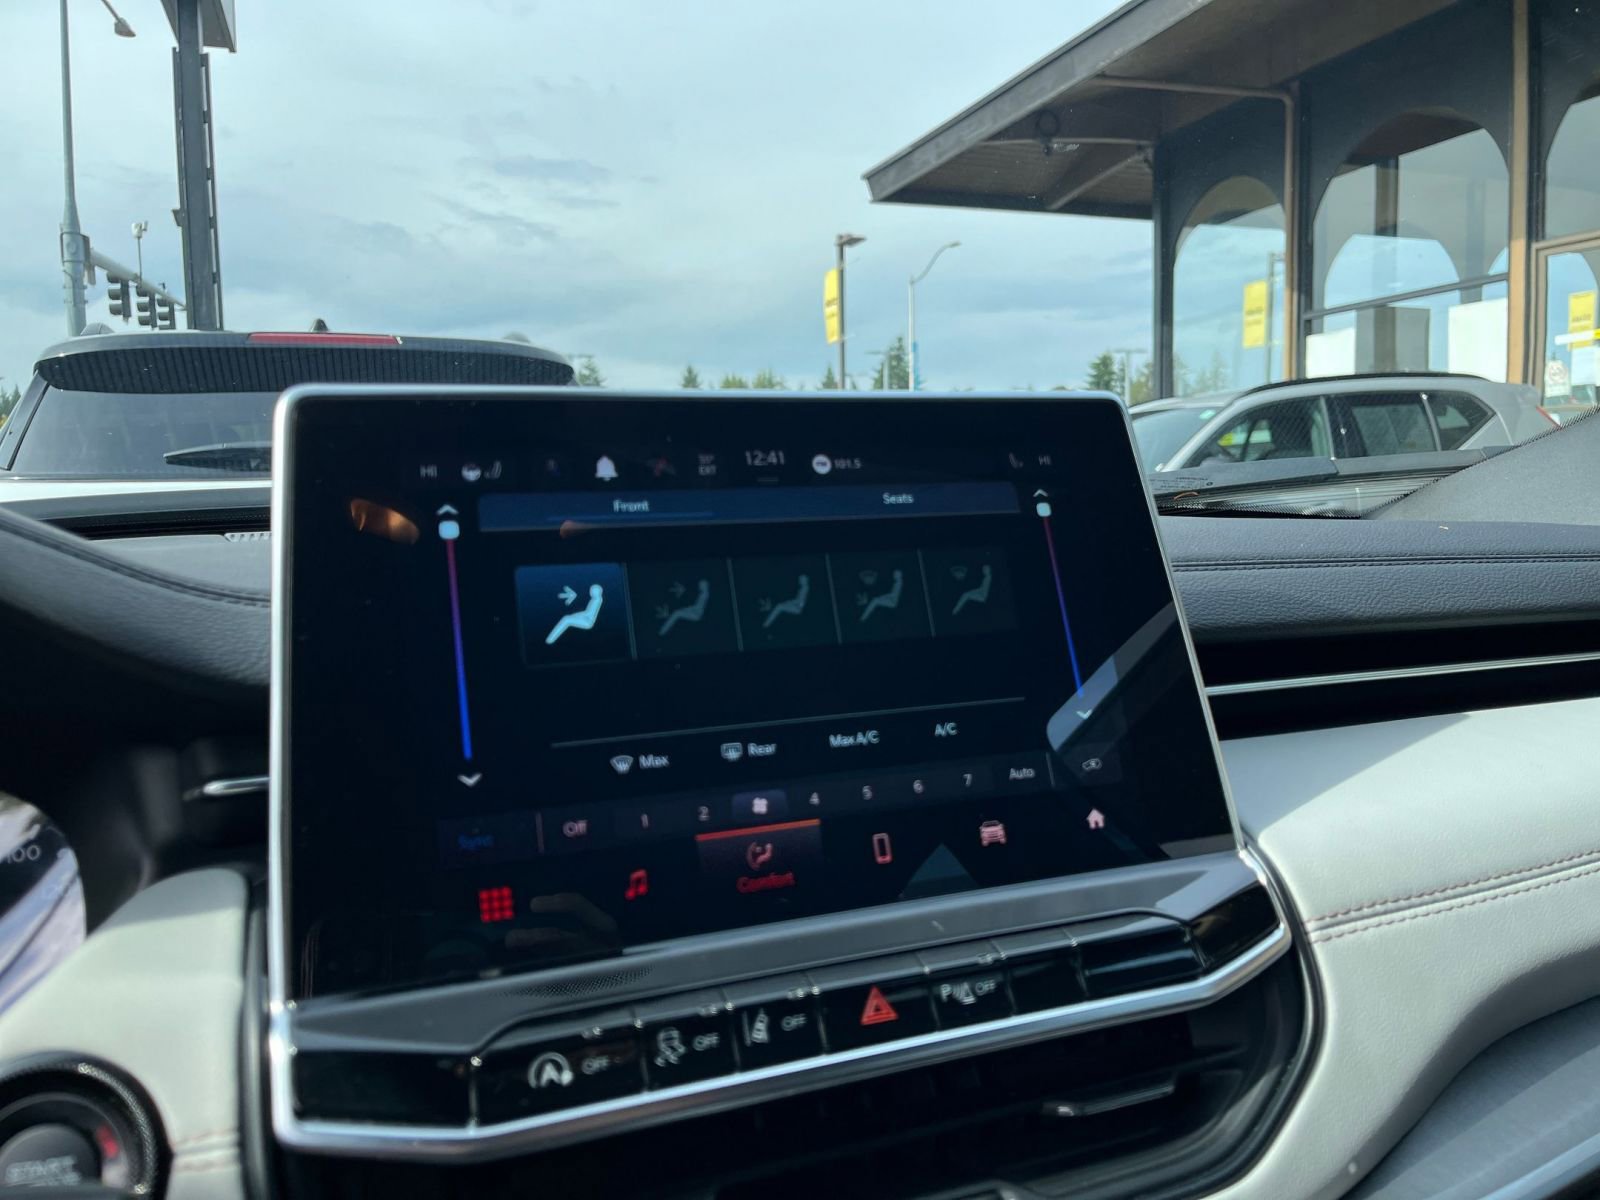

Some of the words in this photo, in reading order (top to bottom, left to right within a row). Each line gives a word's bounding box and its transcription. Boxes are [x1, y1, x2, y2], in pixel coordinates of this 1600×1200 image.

[744, 450, 785, 466] 12:41
[882, 491, 914, 505] Seats
[612, 499, 650, 513] Front
[934, 721, 958, 736] A/C
[829, 733, 855, 748] Max
[855, 730, 880, 746] A/C
[747, 742, 777, 756] Rear
[638, 753, 670, 770] Max
[962, 773, 973, 787] 7
[1008, 766, 1036, 780] Auto
[862, 786, 873, 800] 5
[912, 779, 924, 794] 6
[809, 792, 820, 806] 4
[698, 805, 710, 822] 2
[562, 819, 589, 838] Off
[974, 979, 997, 994] OFF
[781, 1013, 807, 1031] OFF
[693, 1032, 720, 1051] OFF
